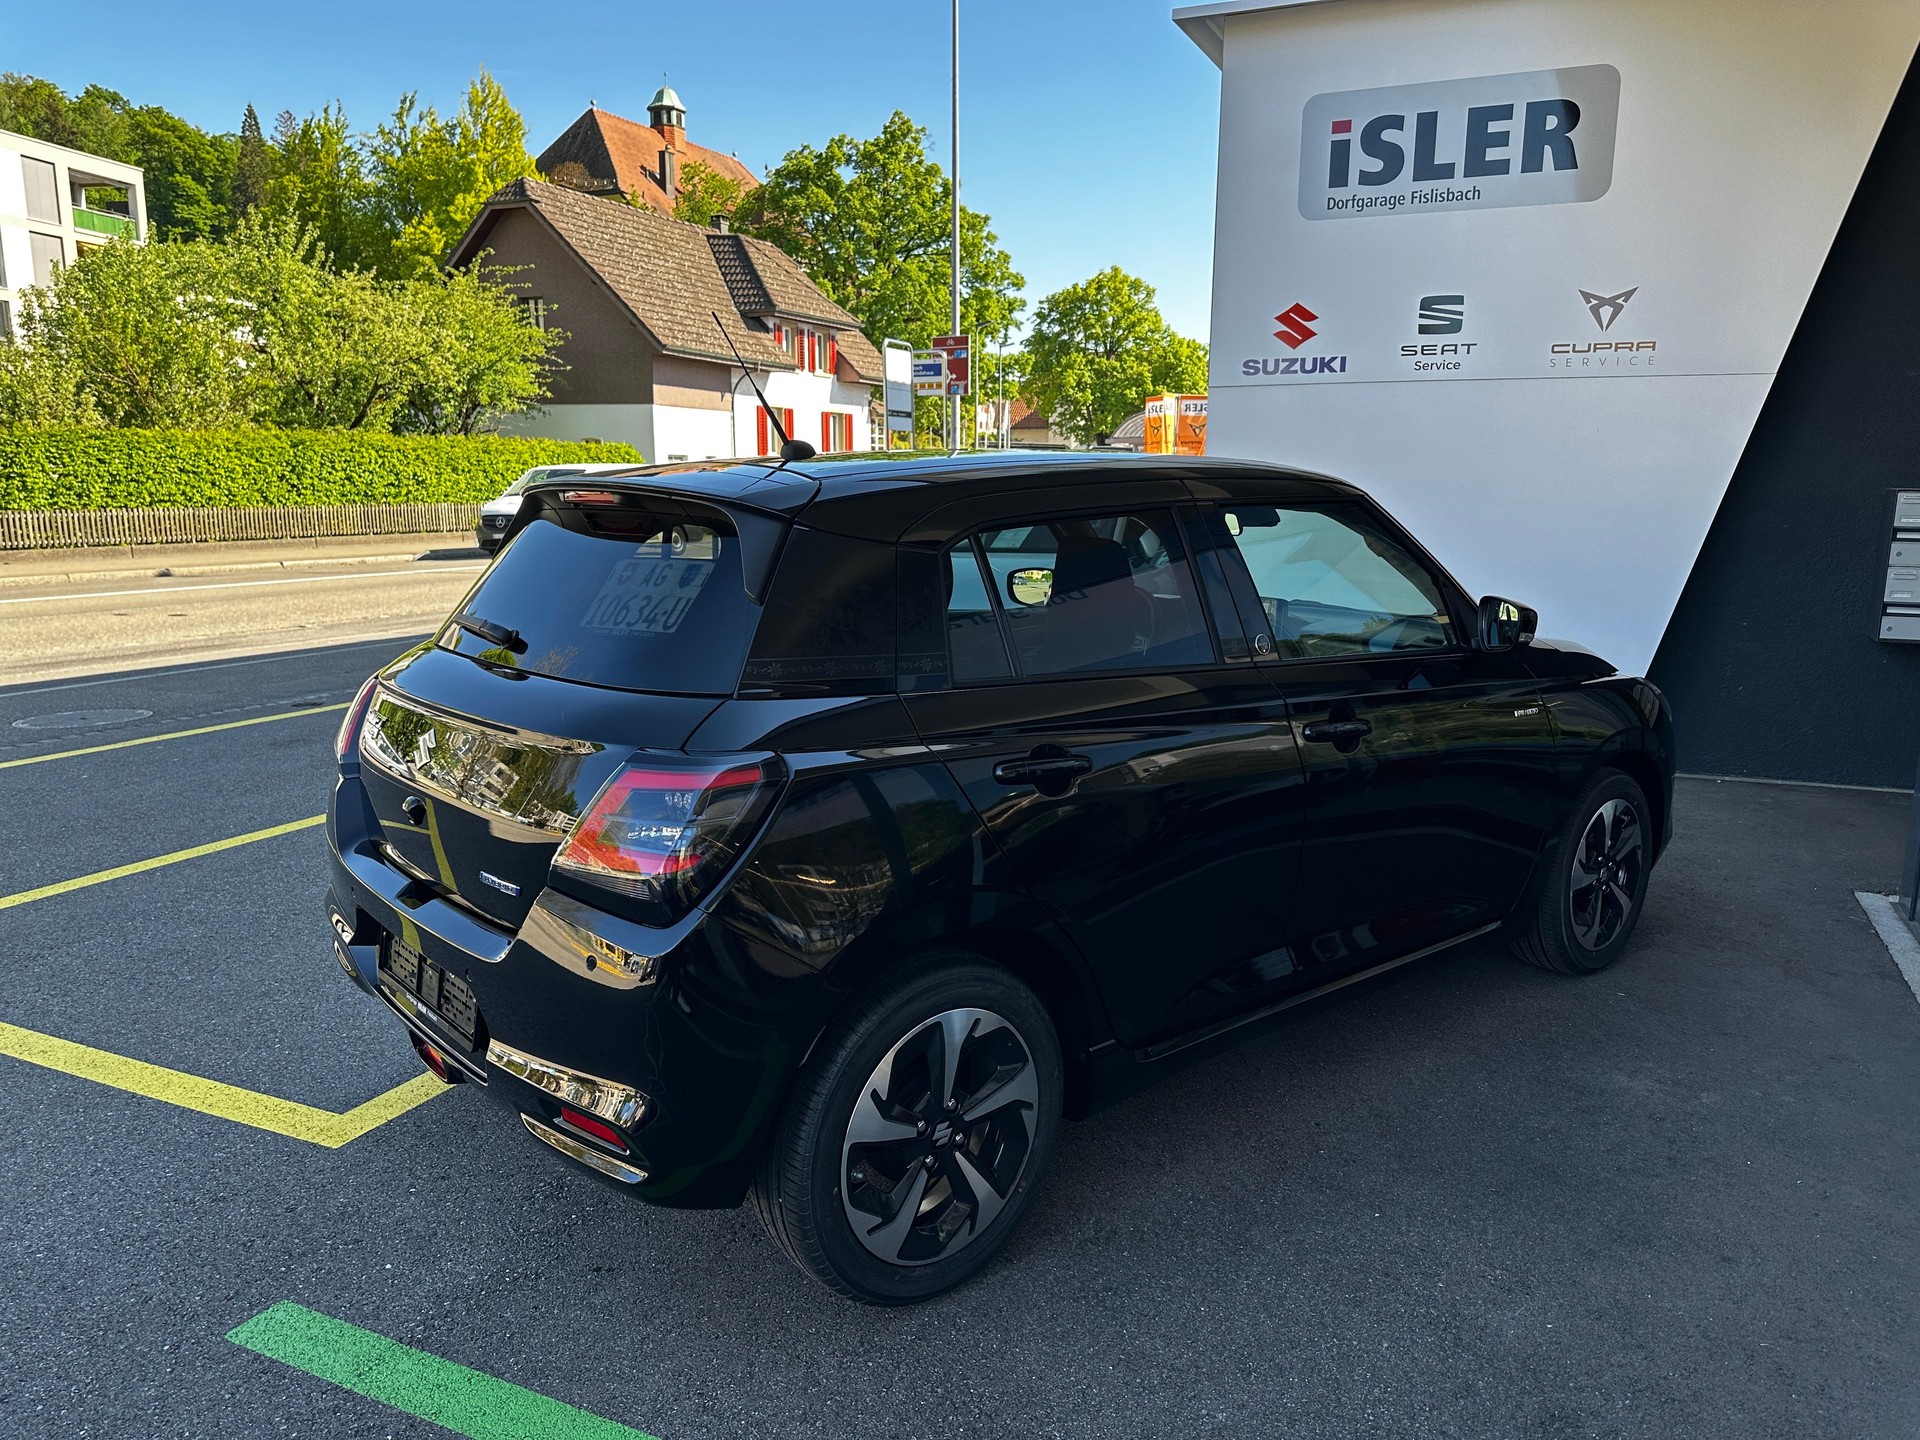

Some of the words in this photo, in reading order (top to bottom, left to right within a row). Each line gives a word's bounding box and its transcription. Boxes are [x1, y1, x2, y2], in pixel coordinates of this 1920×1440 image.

[1327, 192, 1405, 212] Dorfgarage
[1411, 185, 1481, 205] Fislisbach
[1400, 343, 1478, 357] SEAT
[1551, 341, 1657, 354] CUPRA
[1242, 355, 1347, 376] SUZUKI
[1414, 359, 1461, 371] Service
[1549, 355, 1656, 368] SERVICE
[638, 562, 673, 588] AG
